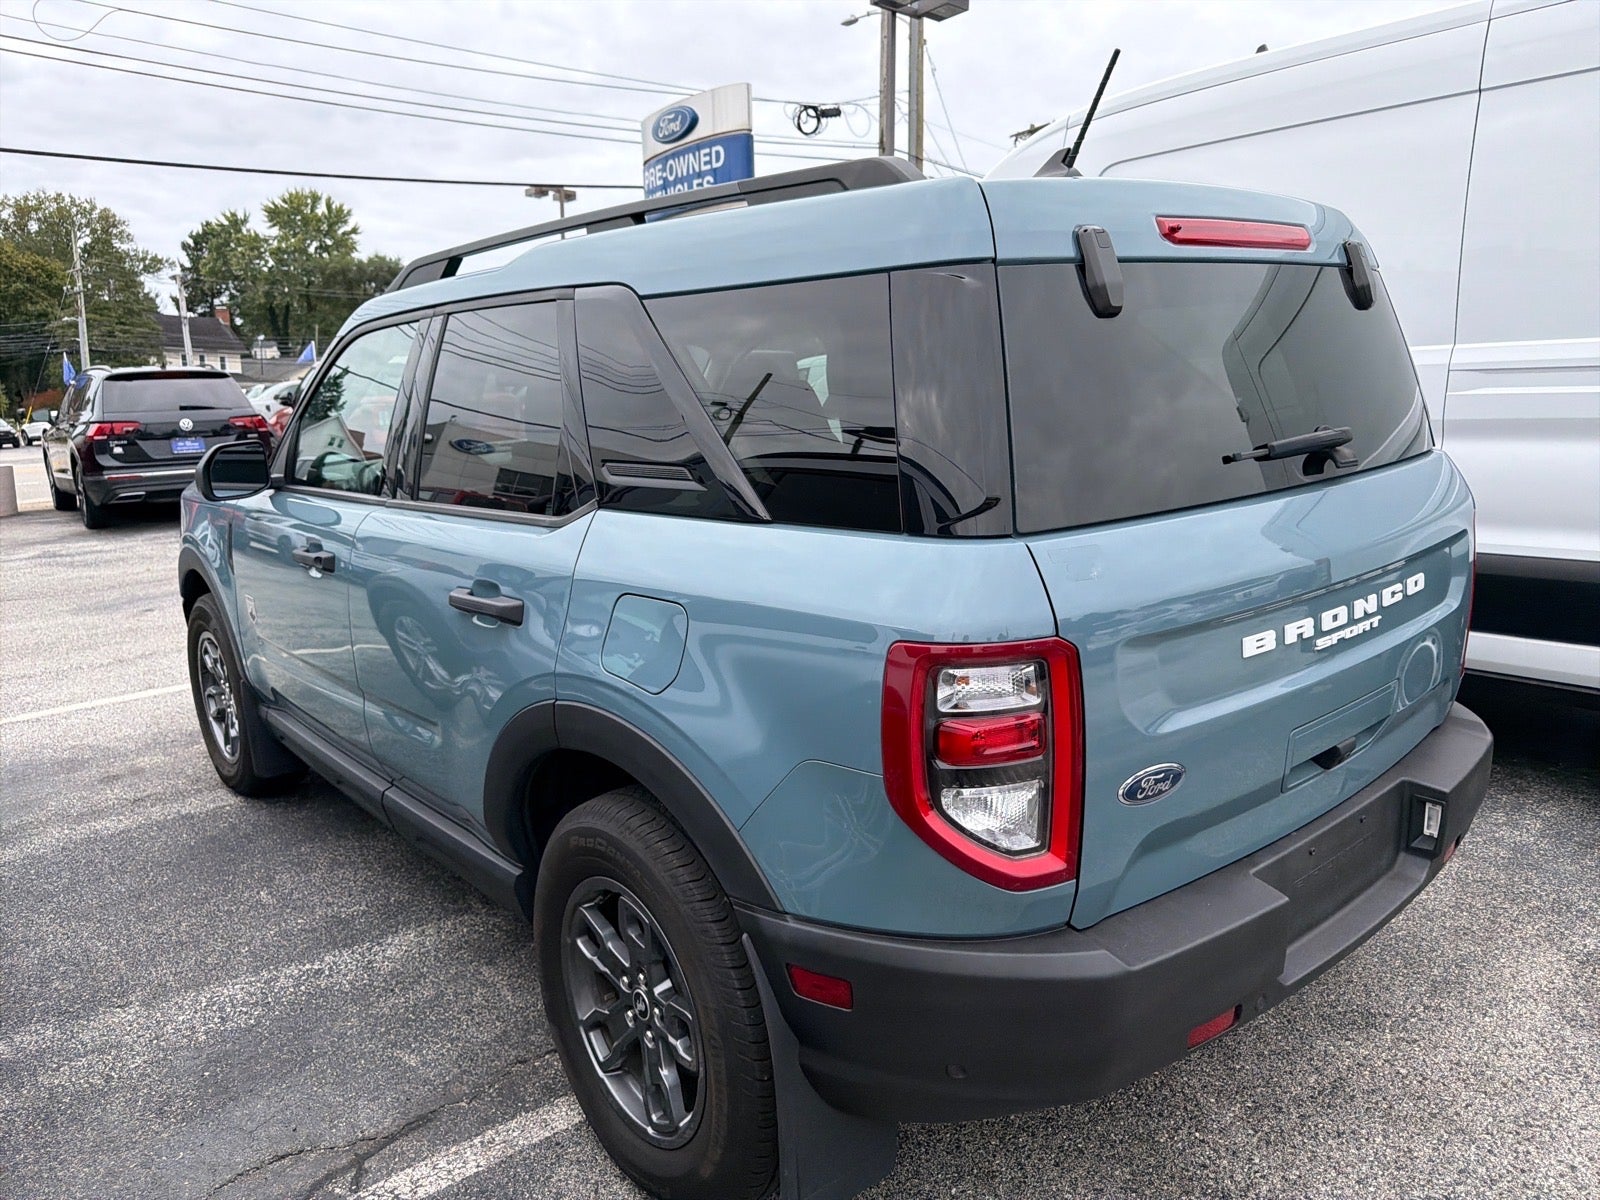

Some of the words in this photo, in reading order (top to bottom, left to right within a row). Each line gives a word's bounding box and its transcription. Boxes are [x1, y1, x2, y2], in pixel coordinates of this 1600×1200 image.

[658, 113, 682, 138] Ford
[644, 144, 725, 192] PRE-OWNED
[1241, 572, 1426, 659] BRONCO
[1314, 615, 1382, 652] SPORT
[1136, 772, 1174, 799] Ford
